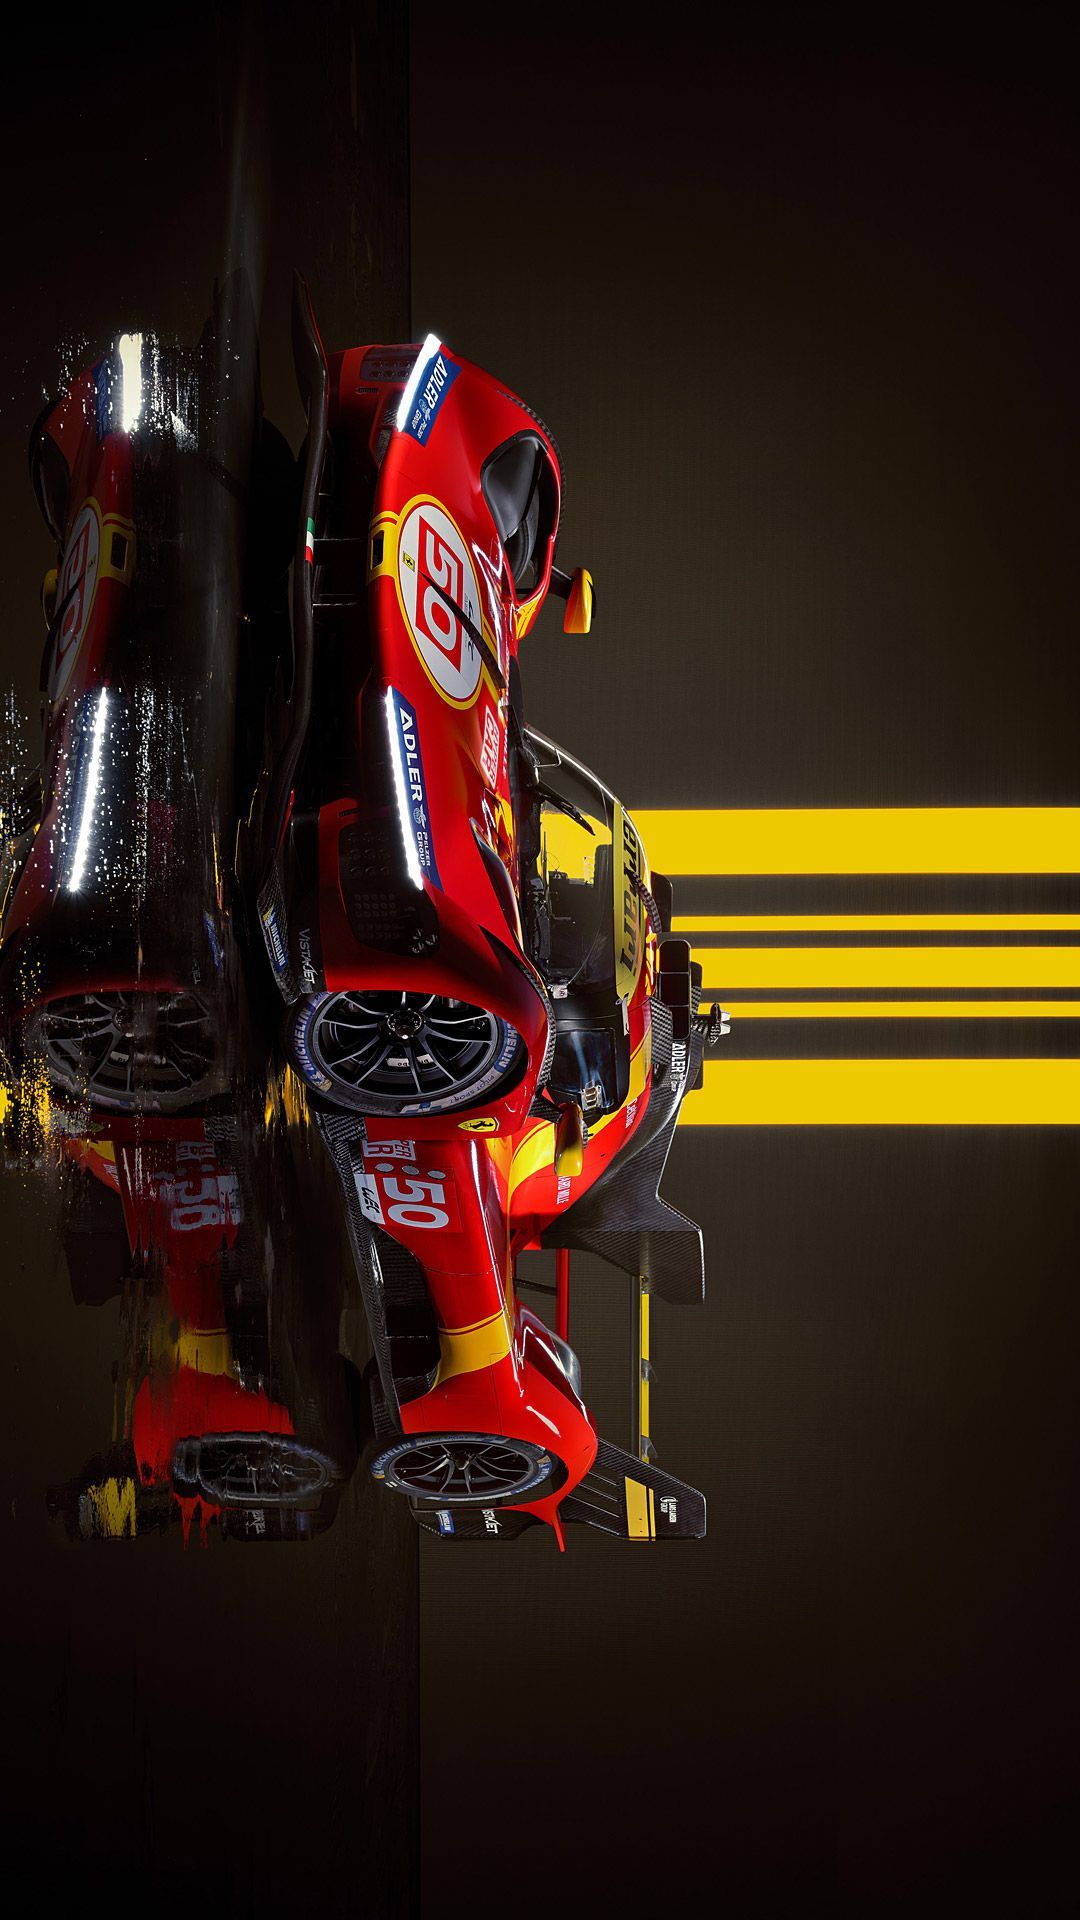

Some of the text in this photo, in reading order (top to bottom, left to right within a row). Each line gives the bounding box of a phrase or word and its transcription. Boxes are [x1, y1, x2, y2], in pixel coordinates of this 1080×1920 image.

[423, 356, 448, 409] ADLER
[423, 529, 458, 651] 50
[399, 707, 423, 801] ADLER
[481, 712, 494, 773] CAR
[416, 832, 426, 866] GROUP
[422, 832, 430, 866] PELZER
[619, 819, 642, 977] errari
[270, 922, 286, 966] MICHELIN
[293, 1008, 314, 1071] MICHELIN
[671, 1042, 686, 1072] ADLER
[394, 1140, 412, 1158] PER
[361, 1186, 380, 1214] WEC
[382, 1177, 449, 1229] 50
